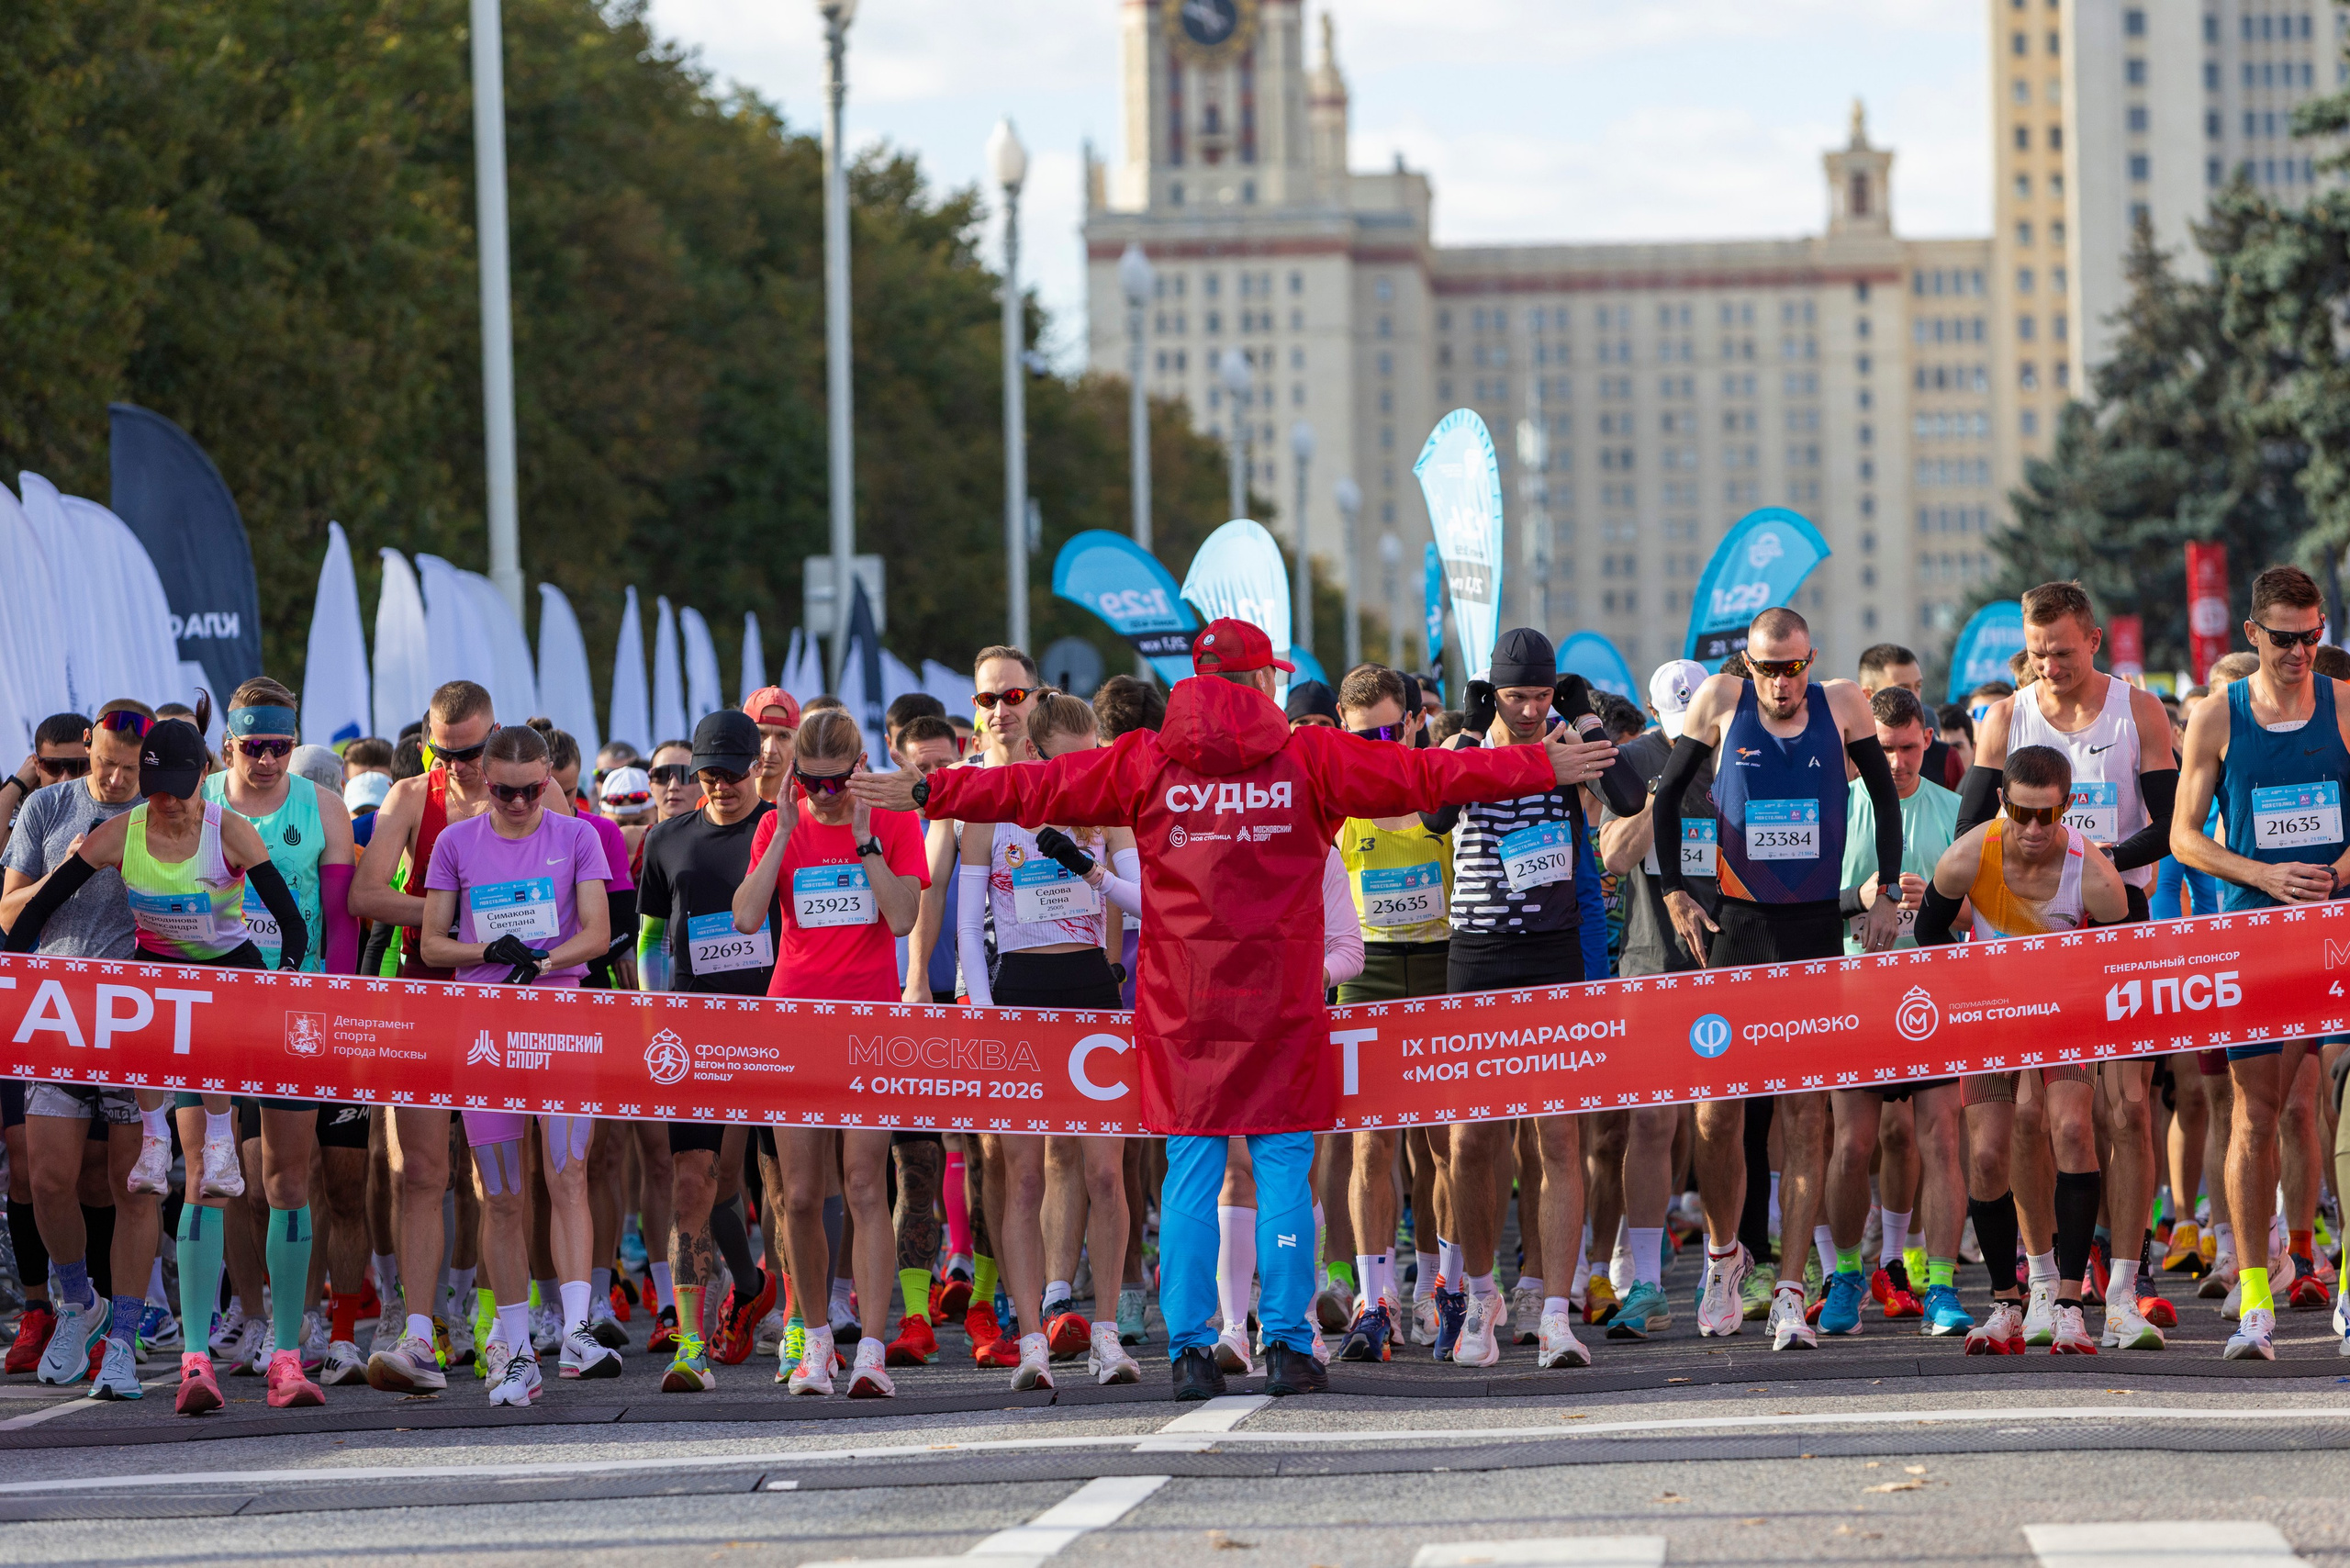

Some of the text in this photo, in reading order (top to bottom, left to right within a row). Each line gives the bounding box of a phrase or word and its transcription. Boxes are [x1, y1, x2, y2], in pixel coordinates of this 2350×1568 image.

[1711, 582, 1771, 615] 1:29
[1165, 781, 1292, 815] СУДЬЯ
[1253, 823, 1292, 834] МОСКОВСКИЙ
[2062, 815, 2096, 829] 176
[2266, 816, 2321, 835] 21635
[1253, 834, 1271, 842] СПОРТ
[1754, 831, 1812, 846] 23384
[1514, 853, 1566, 879] 23870
[1035, 887, 1071, 897] Седова
[1039, 896, 1069, 906] Елена
[803, 896, 861, 915] 23923
[1372, 895, 1428, 914] 23635
[140, 912, 198, 924] Бородинова
[487, 909, 536, 921] Симакова
[489, 918, 535, 930] Светлана
[244, 918, 278, 935] 708
[699, 940, 755, 961] 22693
[2104, 951, 2241, 974] ГЕНЕРАЛЬНЫЙ СПОНСОР
[2152, 970, 2243, 1015] ПСБ
[2328, 980, 2344, 998] 4
[1949, 997, 2009, 1010] ПОЛУМАРАФОН
[0, 976, 213, 1055] АРТ
[1949, 1001, 2061, 1025] МОЯ СТОЛИЦА
[333, 1015, 416, 1030] Департамент
[1743, 1014, 1860, 1046] фармэко
[333, 1030, 376, 1043] спорта
[507, 1031, 603, 1054] МОСКОВСКИЙ
[1402, 1019, 1627, 1057] IX ПОЛУМАРАФОН
[333, 1045, 427, 1059] города Москвы
[506, 1051, 552, 1070] СПОРТ
[695, 1044, 780, 1061] фармэко
[848, 1035, 1041, 1072] МОСКВА
[694, 1060, 795, 1072] БЕГОМ ПО ЗОЛОТОМУ
[1402, 1050, 1607, 1083] «МОЯ СТОЛИЦА»
[693, 1072, 733, 1081] КОЛЬЦУ
[849, 1076, 1044, 1100] 4 ОКТЯБРЯ 2026
